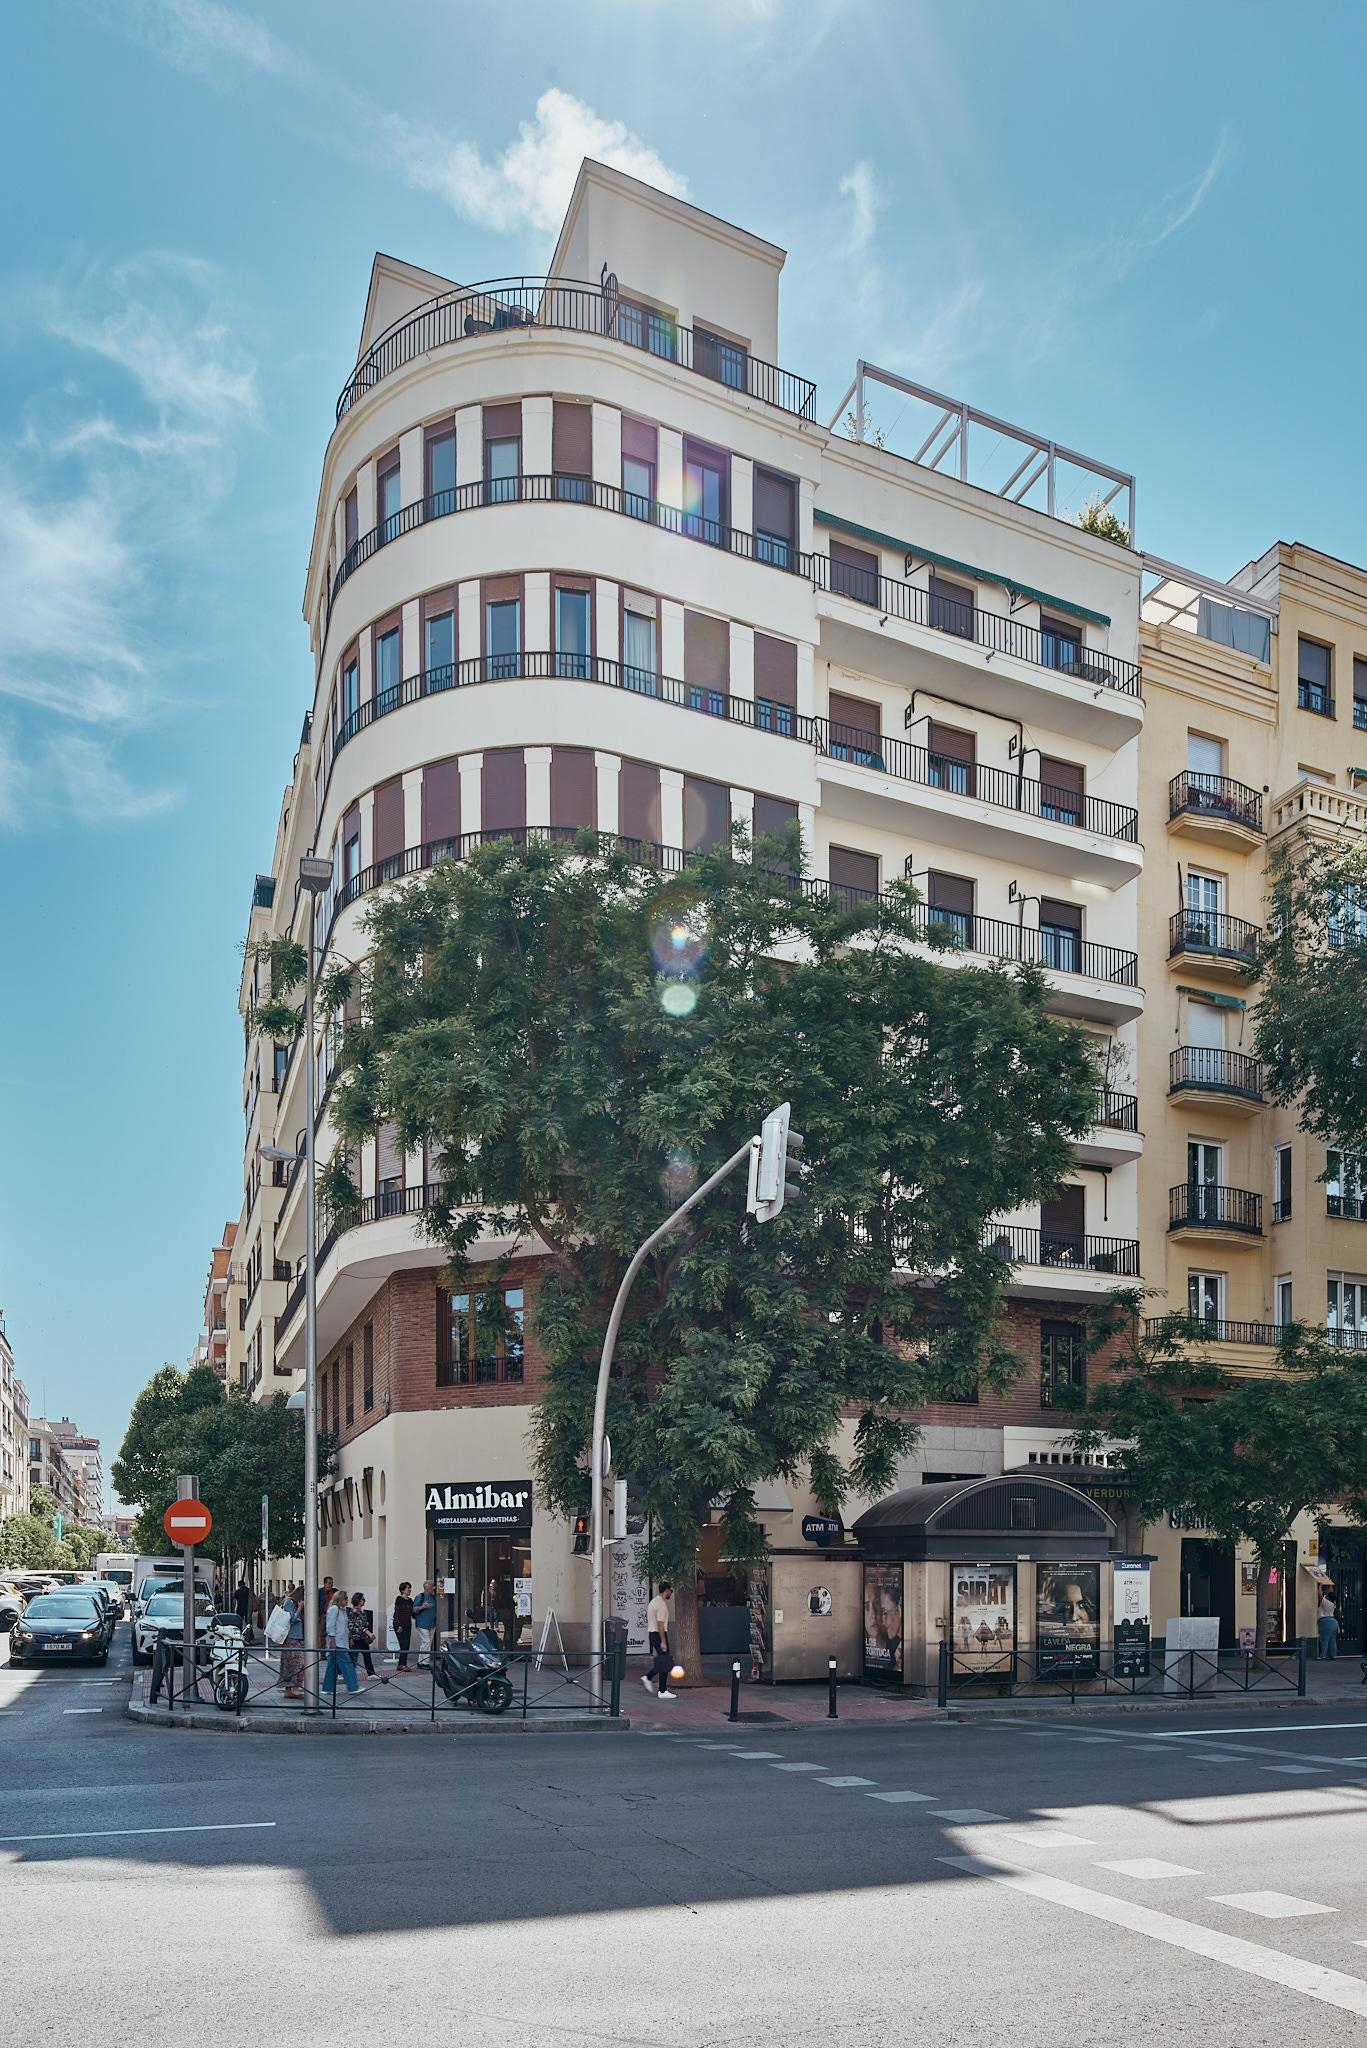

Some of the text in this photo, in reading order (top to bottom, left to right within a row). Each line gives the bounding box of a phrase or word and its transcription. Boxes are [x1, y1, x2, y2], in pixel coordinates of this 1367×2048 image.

[425, 1485, 529, 1511] Almibar
[805, 1523, 825, 1532] ATM
[828, 1523, 839, 1532] ATM
[865, 1637, 877, 1647] LOS
[1065, 1643, 1092, 1651] NEGRA
[865, 1646, 891, 1658] TORTUGA
